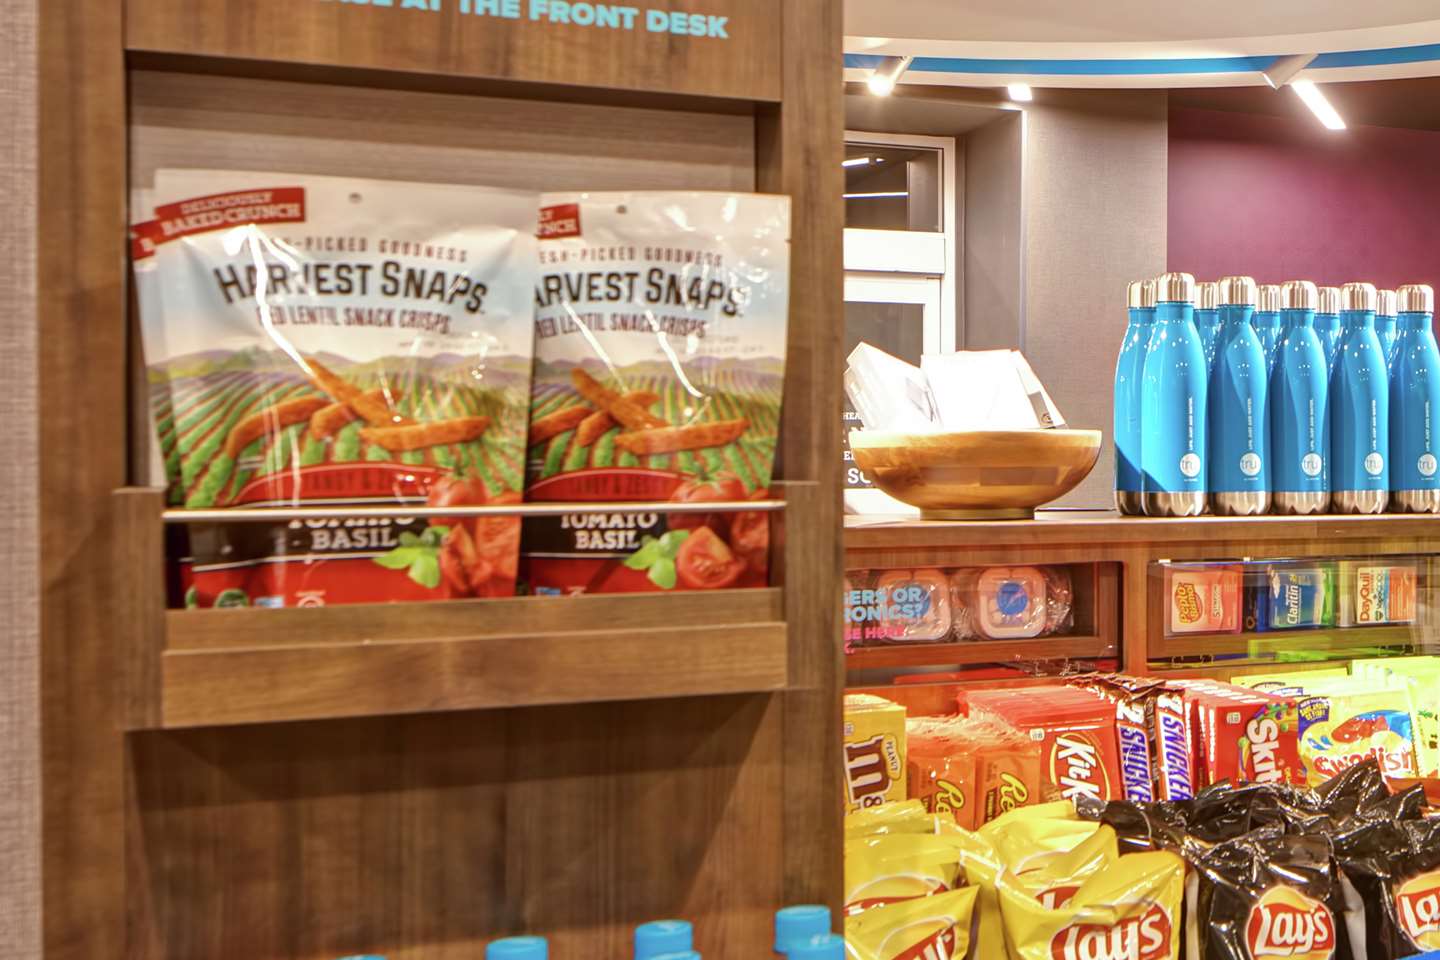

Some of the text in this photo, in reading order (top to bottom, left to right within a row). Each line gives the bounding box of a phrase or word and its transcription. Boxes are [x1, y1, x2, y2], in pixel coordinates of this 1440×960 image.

[459, 0, 520, 19] THE
[529, 0, 641, 30] FRONT
[646, 11, 729, 39] DESK
[381, 261, 488, 315] SNAPS
[535, 271, 640, 309] ARVEST
[345, 306, 396, 328] SNACK
[311, 527, 397, 550] BASIL
[575, 530, 641, 550] BASIL
[891, 587, 922, 603] OR
[1287, 584, 1299, 625] Claritin
[1360, 571, 1372, 622] DayQuil
[886, 741, 899, 773] PEANUT
[1253, 903, 1327, 958] Lay's
